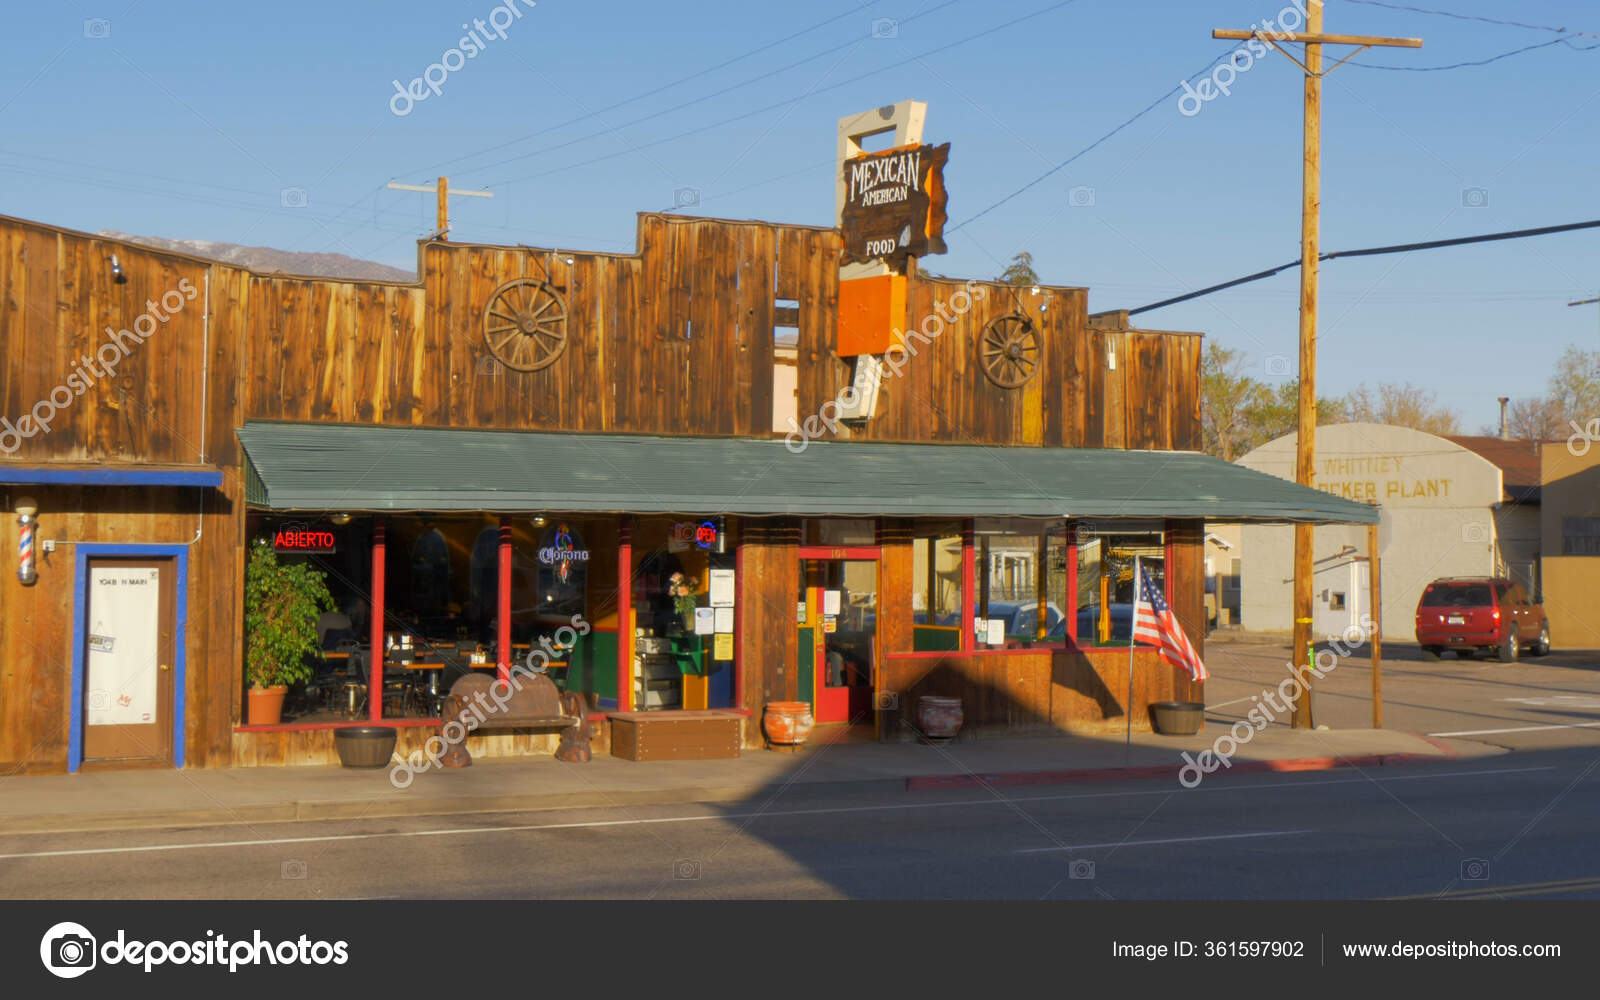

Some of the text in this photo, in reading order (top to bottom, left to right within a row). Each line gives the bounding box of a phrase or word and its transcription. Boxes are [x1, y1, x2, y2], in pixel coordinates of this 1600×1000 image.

[850, 152, 921, 203] MEXICAN
[862, 185, 908, 207] AMERICAN
[865, 239, 896, 257] FOOD
[1324, 456, 1404, 476] WHITNEY
[1386, 478, 1452, 498] PLANT
[274, 530, 335, 548] ABIERTO
[539, 546, 590, 565] Corona
[128, 578, 149, 586] MAIN
